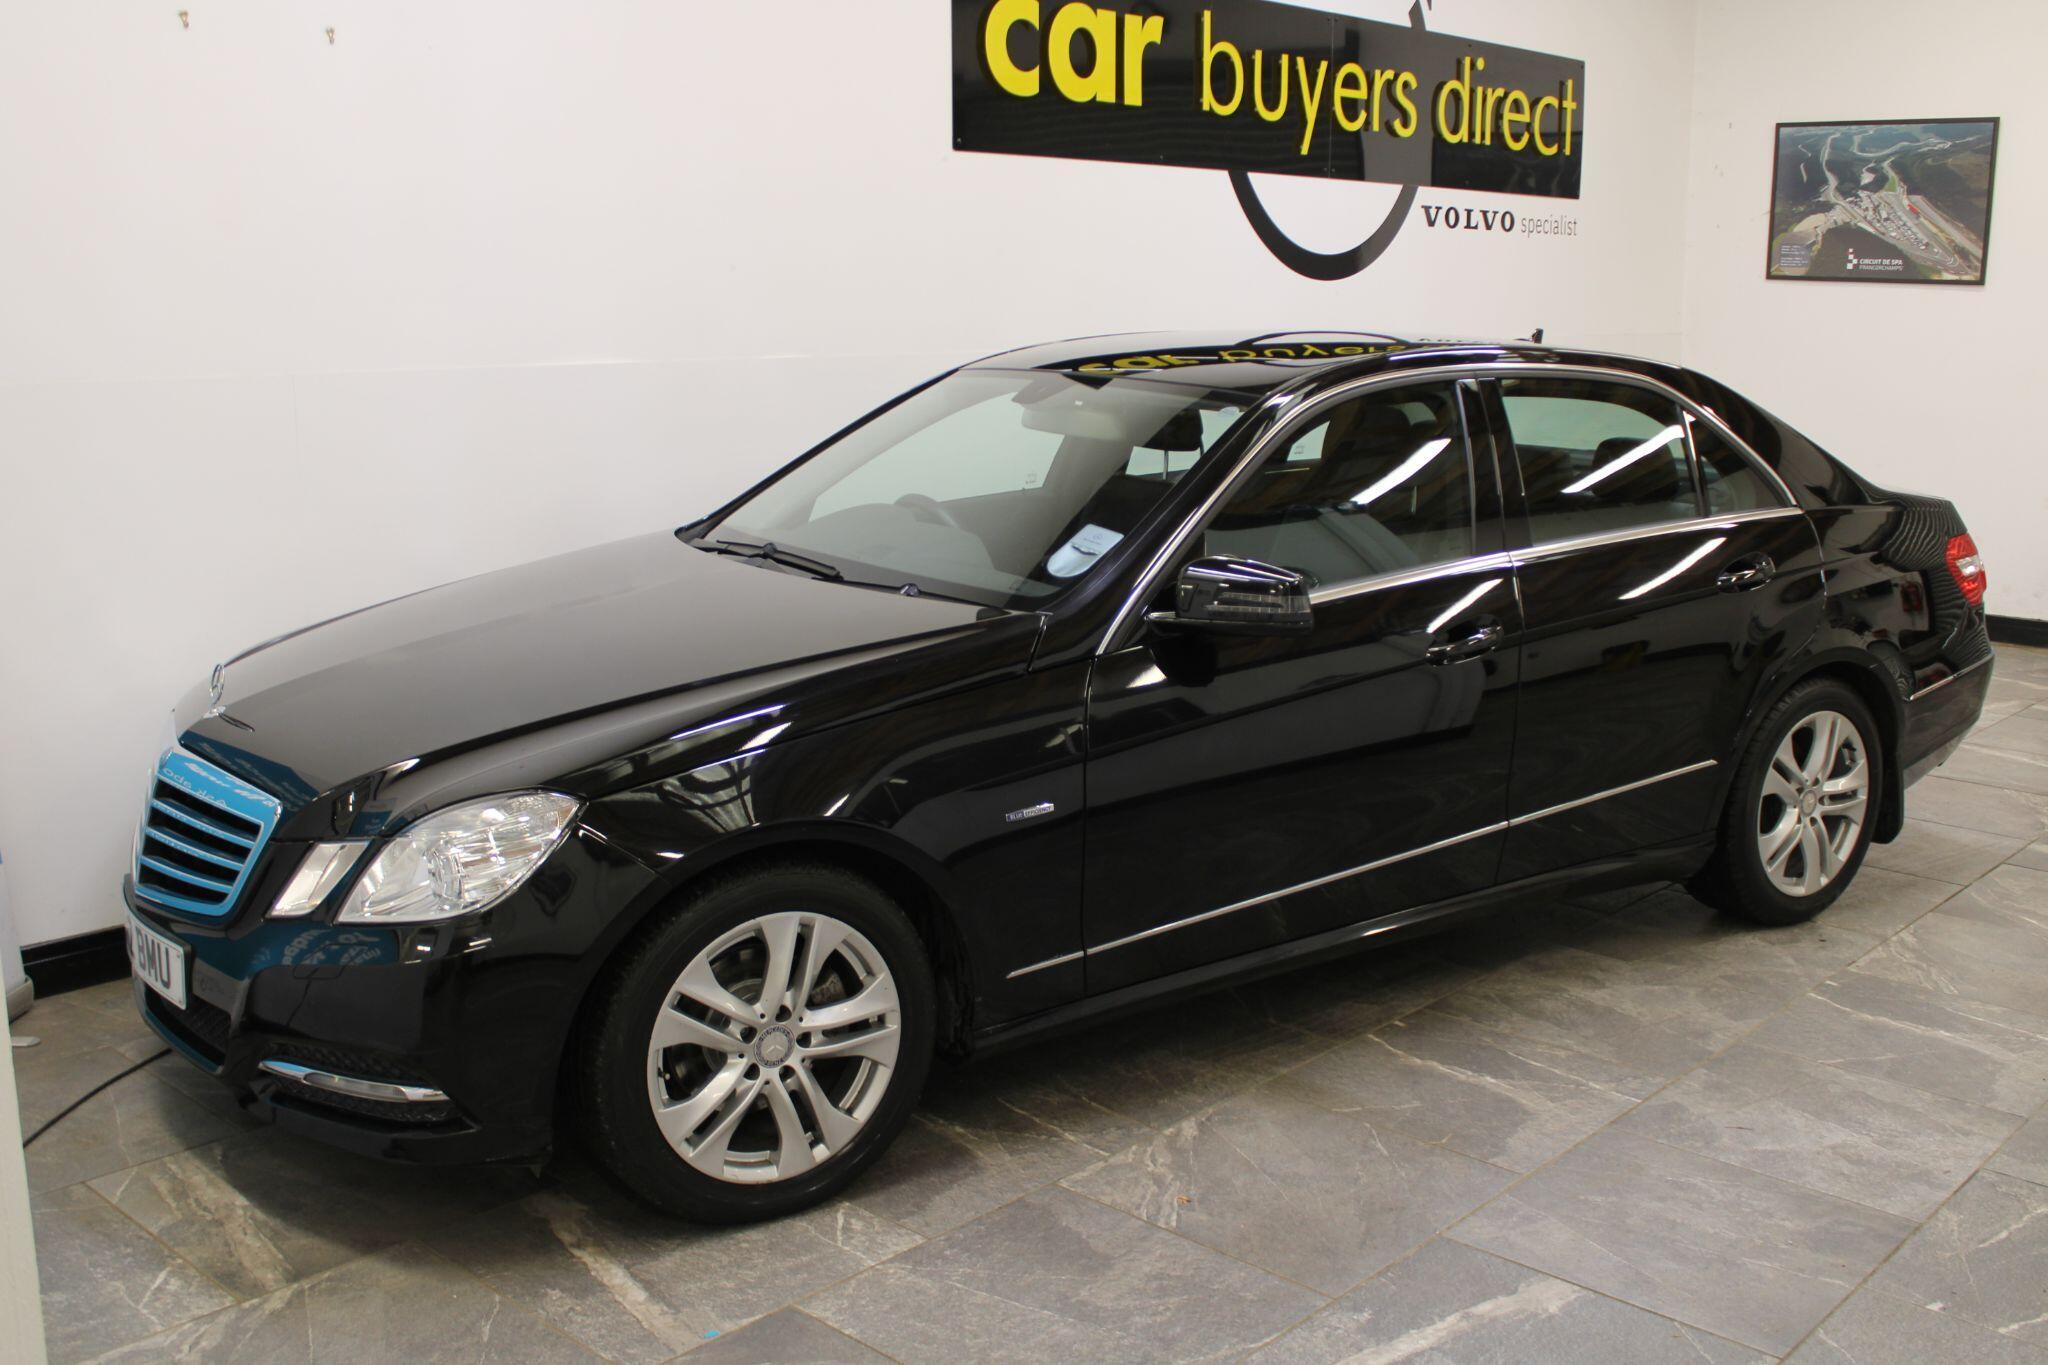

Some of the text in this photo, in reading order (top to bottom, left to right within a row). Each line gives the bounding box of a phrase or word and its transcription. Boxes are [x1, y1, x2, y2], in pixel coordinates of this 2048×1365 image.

[985, 0, 1577, 156] car buyers direct
[1421, 205, 1578, 238] VOLVO specialist
